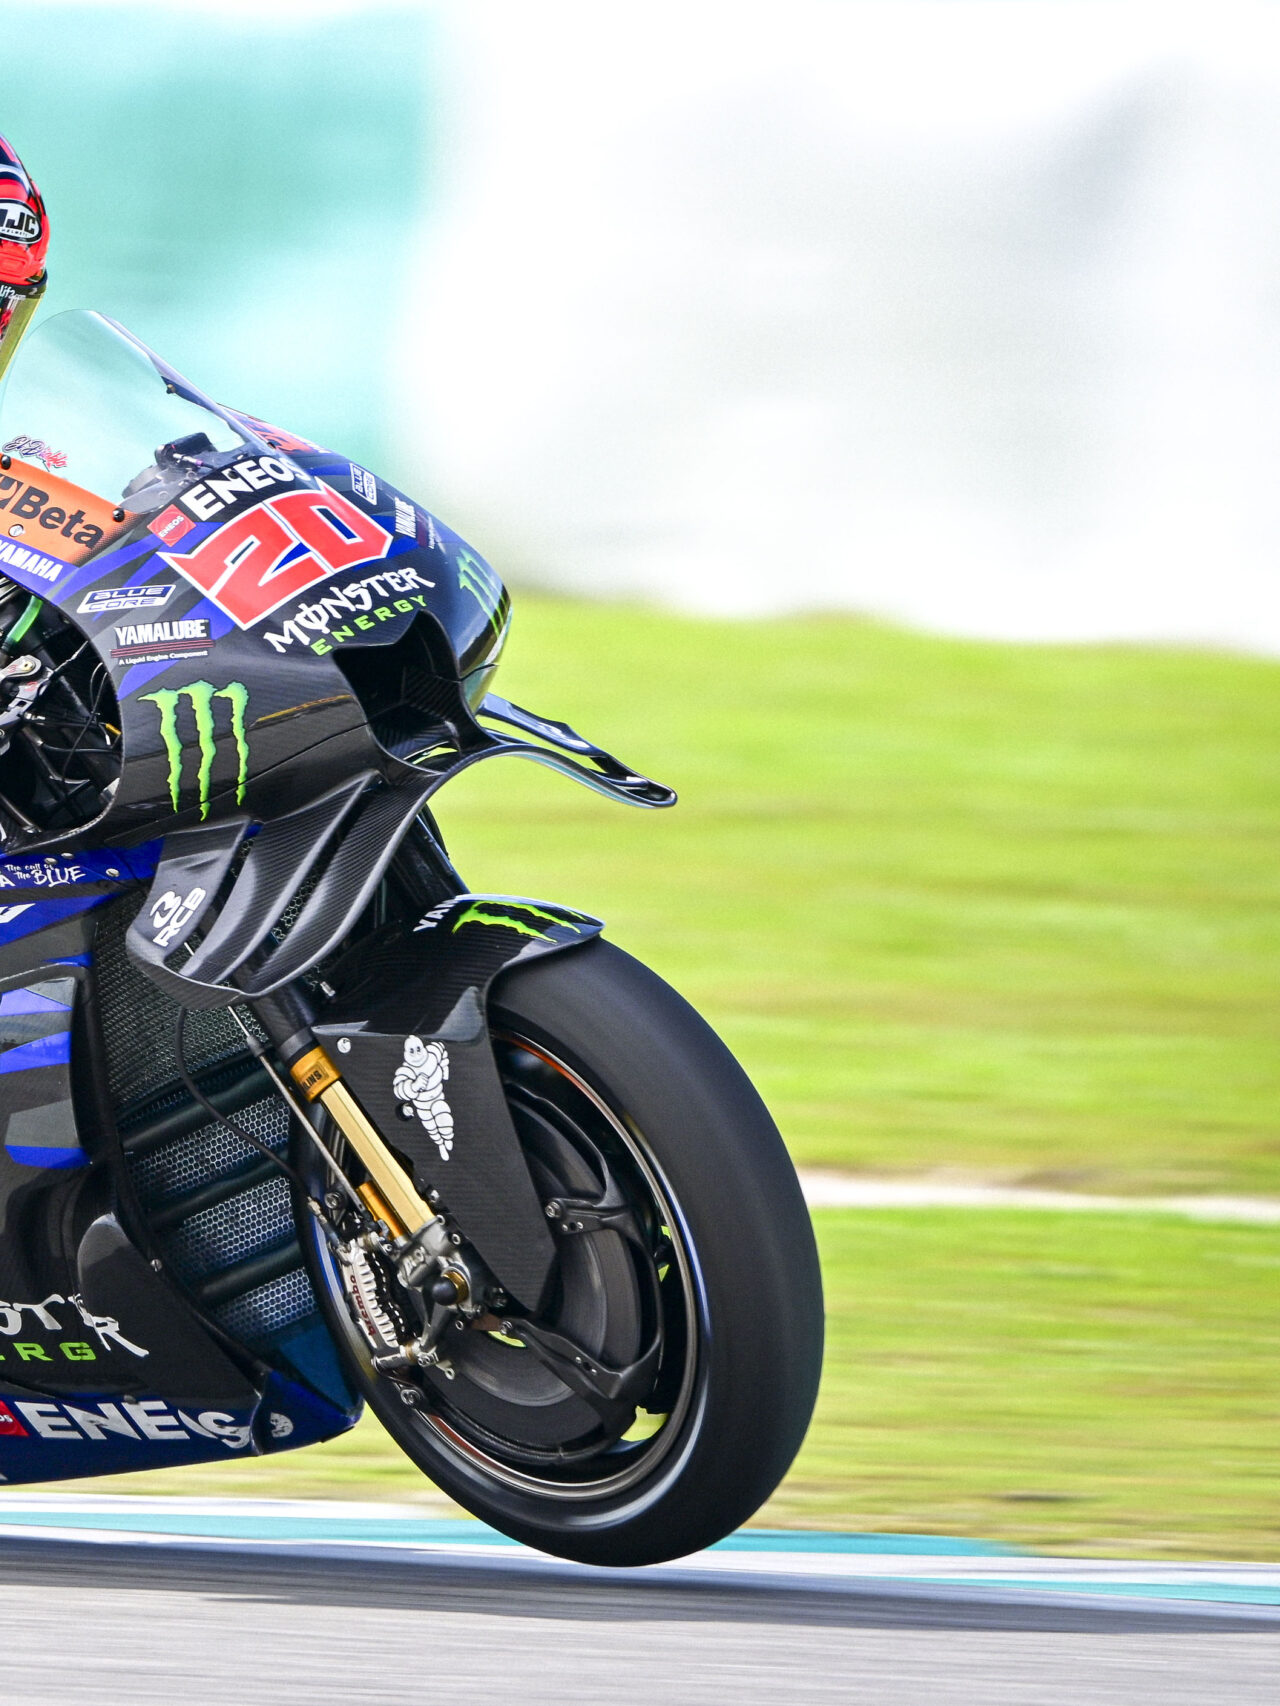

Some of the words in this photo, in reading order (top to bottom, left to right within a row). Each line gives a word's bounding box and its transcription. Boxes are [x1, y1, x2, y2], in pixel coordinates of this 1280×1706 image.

[10, 486, 104, 550] Beta
[179, 456, 311, 521] ENEOS
[155, 475, 395, 632] 20
[158, 515, 185, 538] ENEOS
[88, 598, 157, 611] CORE
[93, 587, 165, 601] BLUE
[263, 567, 436, 654] MONSTER
[114, 619, 209, 646] YAMALUBE
[310, 595, 427, 656] ENERGY
[30, 865, 86, 888] BLUE
[153, 887, 207, 947] RCB
[350, 1275, 377, 1336] brembo
